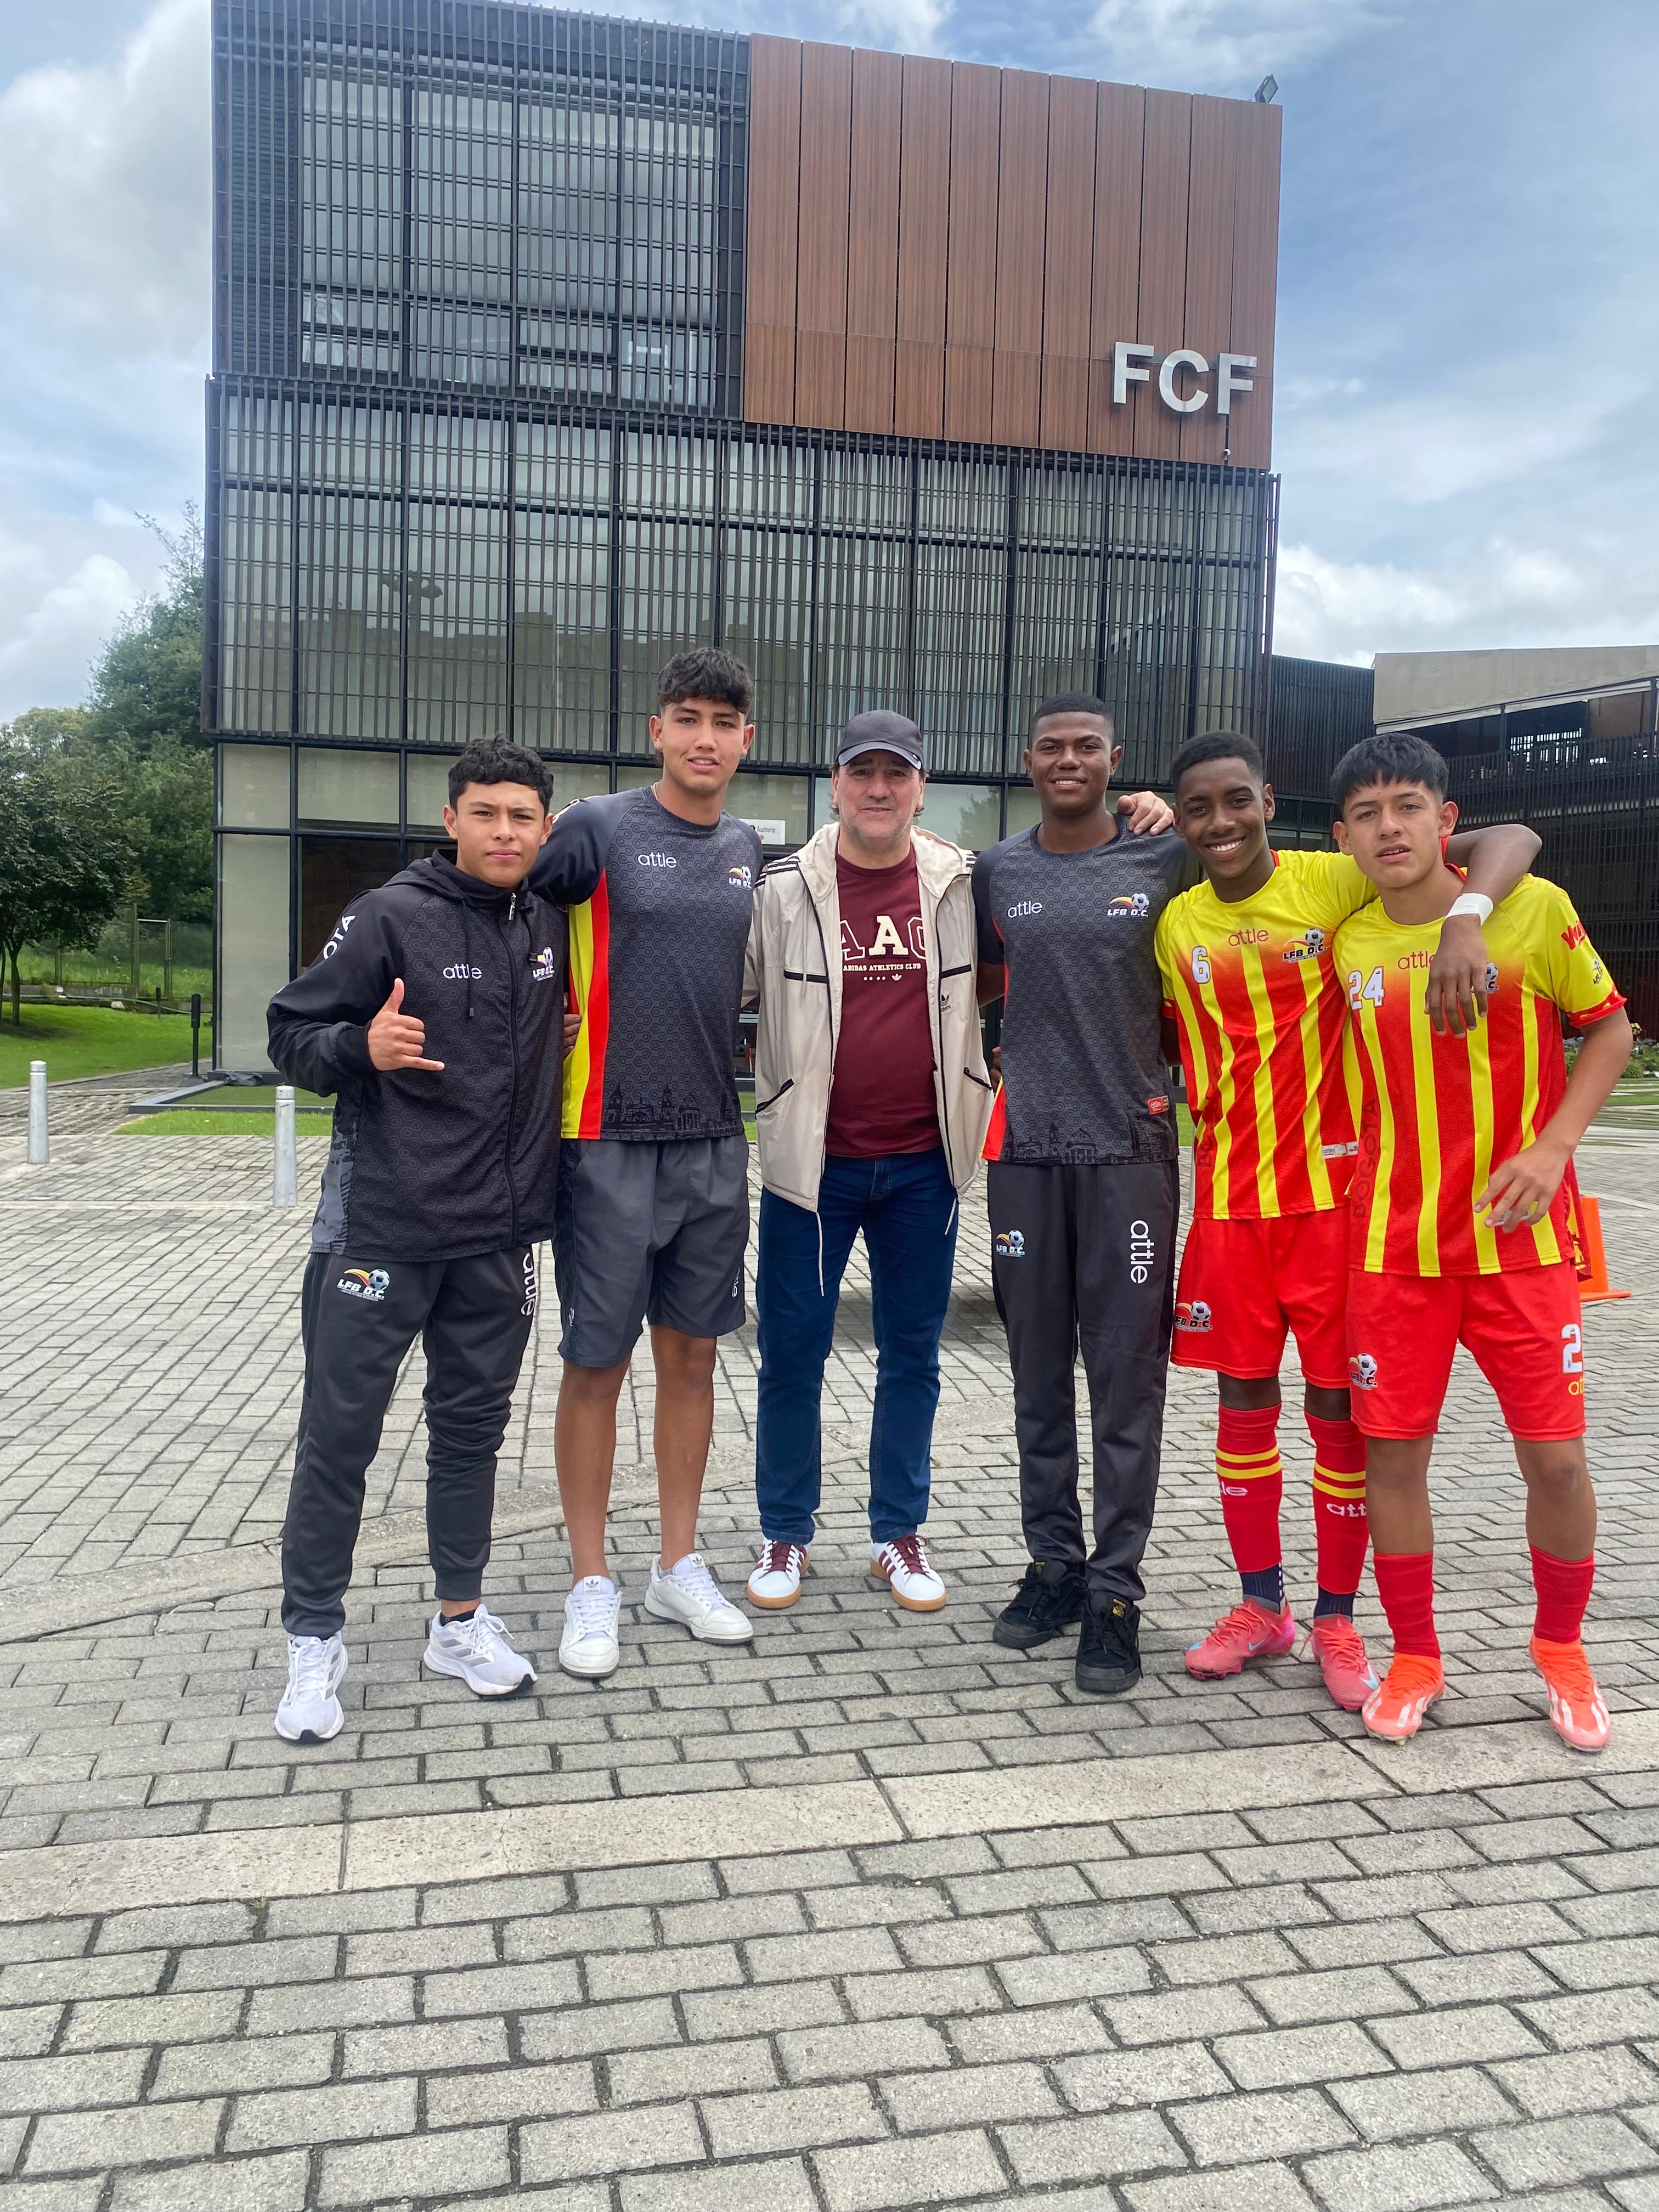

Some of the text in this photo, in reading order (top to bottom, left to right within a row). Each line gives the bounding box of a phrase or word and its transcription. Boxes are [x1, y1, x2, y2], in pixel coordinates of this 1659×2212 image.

[1114, 342, 1257, 414] FCF
[637, 851, 677, 868] attle
[729, 877, 742, 886] LFB
[1008, 900, 1042, 918] attle
[1228, 928, 1269, 946] attle
[1284, 949, 1304, 960] LFB
[1307, 944, 1327, 955] D.C.
[443, 963, 482, 979] attle
[532, 967, 545, 978] LFB
[1192, 945, 1211, 984] 6
[1348, 966, 1386, 1011] 24
[996, 1244, 1025, 1254] LFB D.C.
[1130, 1220, 1154, 1284] attle
[337, 1278, 385, 1299] LFB D.C.
[1175, 1316, 1187, 1325] FB
[1561, 1323, 1584, 1374] 2
